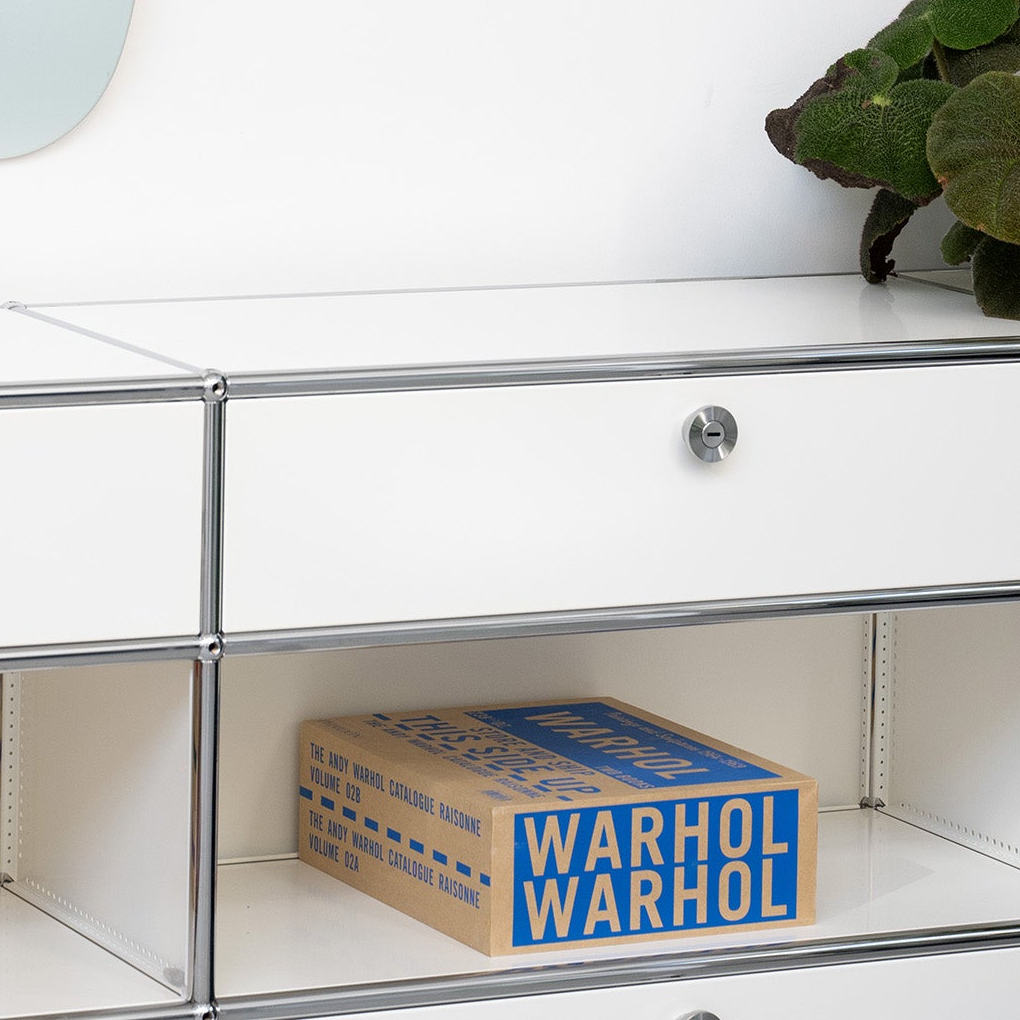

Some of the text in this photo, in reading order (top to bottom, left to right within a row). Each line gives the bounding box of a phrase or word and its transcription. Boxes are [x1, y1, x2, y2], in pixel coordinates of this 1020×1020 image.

[310, 765, 361, 804] VOLUME 02B
[400, 715, 481, 743] THIS
[467, 746, 556, 774] SIDE
[539, 777, 602, 794] UP
[469, 727, 596, 776] STORE AND SHIP
[524, 711, 710, 780] WARHOL
[310, 742, 481, 837] THE ANDY WARHOL CATALOGUE RAISONNE
[309, 833, 360, 873] VOLUME 02A
[309, 810, 480, 909] THE ANDY WARHOL CATALOGUE RAISONNE
[523, 795, 789, 877] WARHOL
[523, 859, 788, 941] WARHOL
